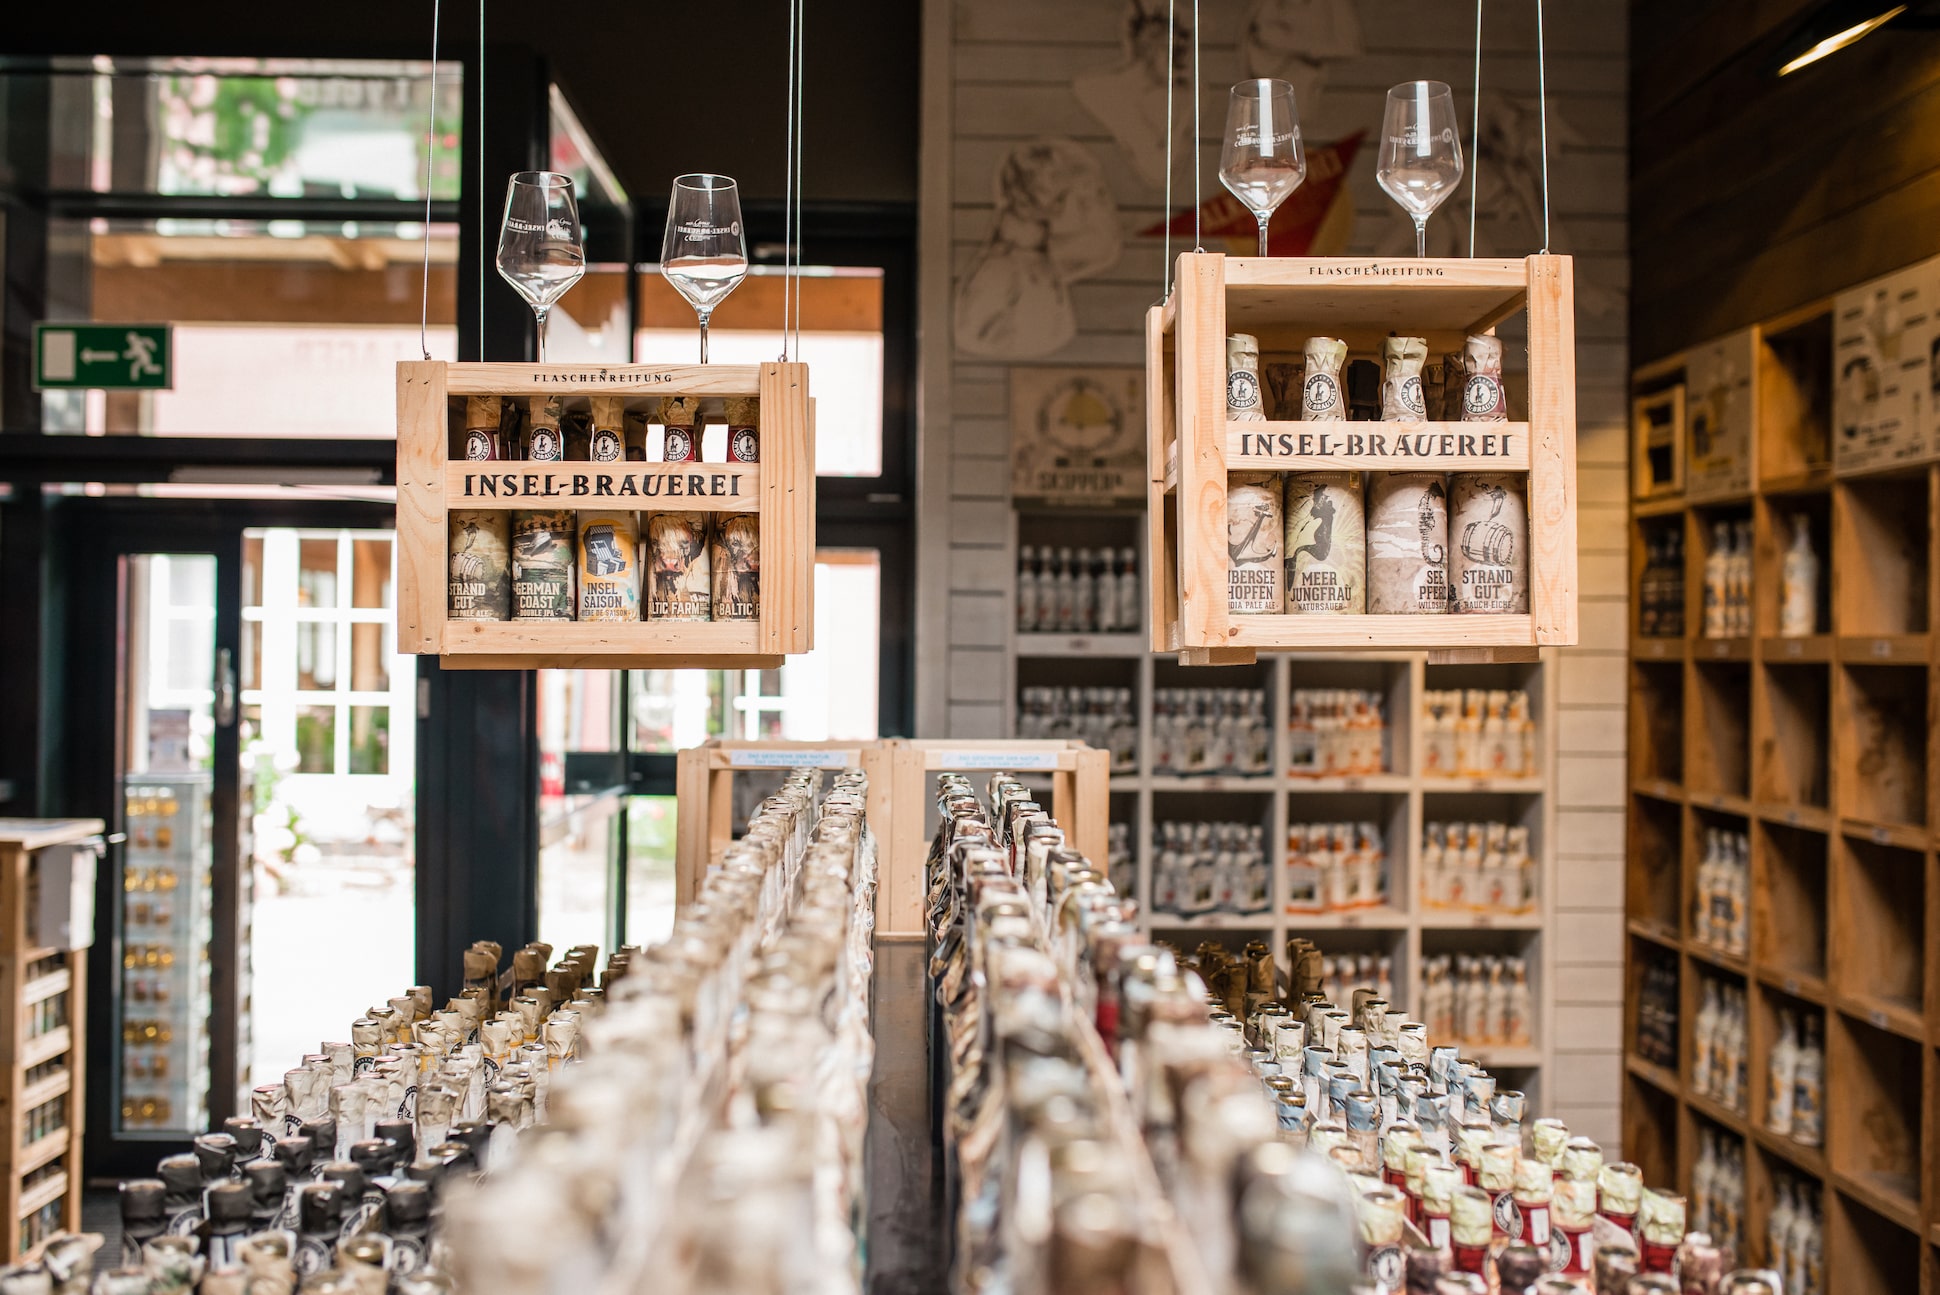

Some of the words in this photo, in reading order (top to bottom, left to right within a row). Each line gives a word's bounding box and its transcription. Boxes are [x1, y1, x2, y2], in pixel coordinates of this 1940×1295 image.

[1309, 267, 1444, 276] FLASCHENREIFUNG
[534, 374, 672, 383] FLASCHENREIFUNG
[1240, 433, 1513, 458] INSEL-BRAUEREI
[463, 474, 743, 498] INSEL-BRAUEREI
[1302, 572, 1337, 585] MEER
[1427, 570, 1443, 584] SEE
[1462, 570, 1513, 584] STRAND
[516, 583, 560, 596] GERMAN
[587, 582, 618, 595] INSEL
[1475, 585, 1500, 599] GUT
[454, 596, 474, 609] GUT
[519, 596, 554, 609] COAST
[584, 596, 622, 608] SAISON
[671, 602, 700, 615] FARM
[1246, 601, 1263, 609] PALE
